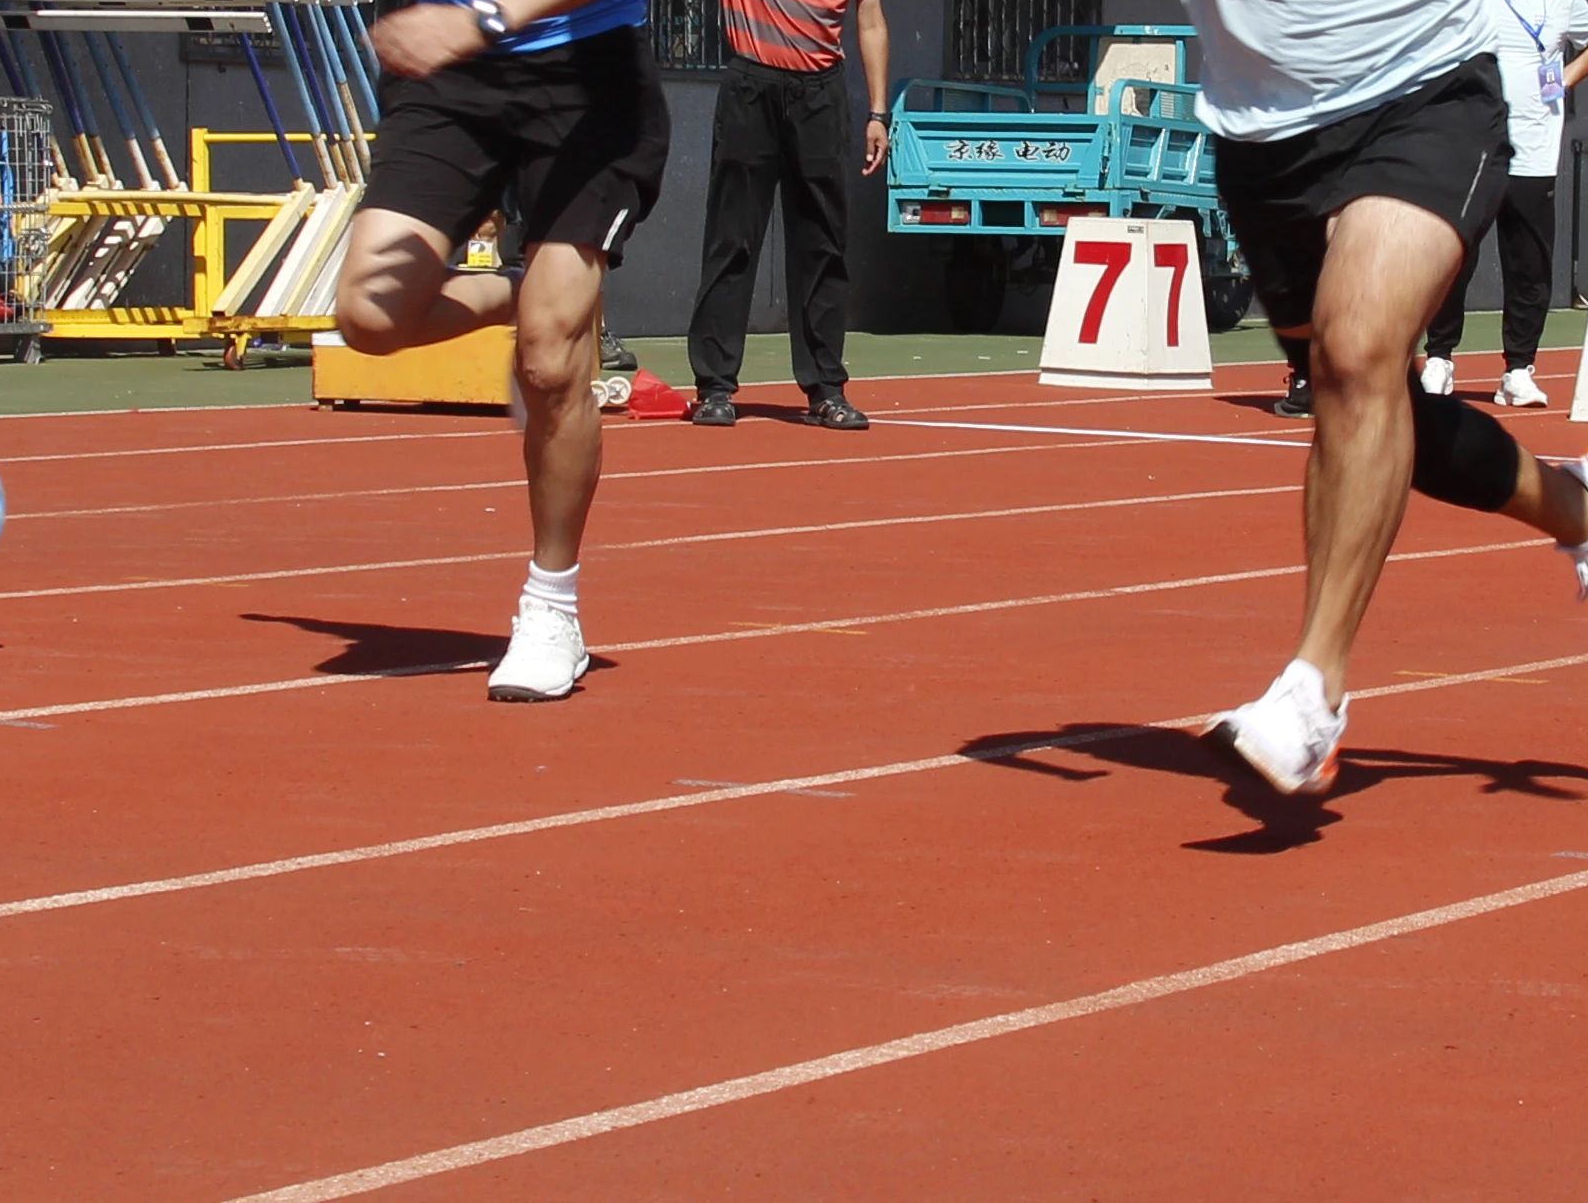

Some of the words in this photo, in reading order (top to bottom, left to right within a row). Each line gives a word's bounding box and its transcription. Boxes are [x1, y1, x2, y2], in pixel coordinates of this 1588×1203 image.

[1016, 141, 1071, 161] 电动
[1074, 241, 1132, 343] 7
[1154, 244, 1188, 347] 7
